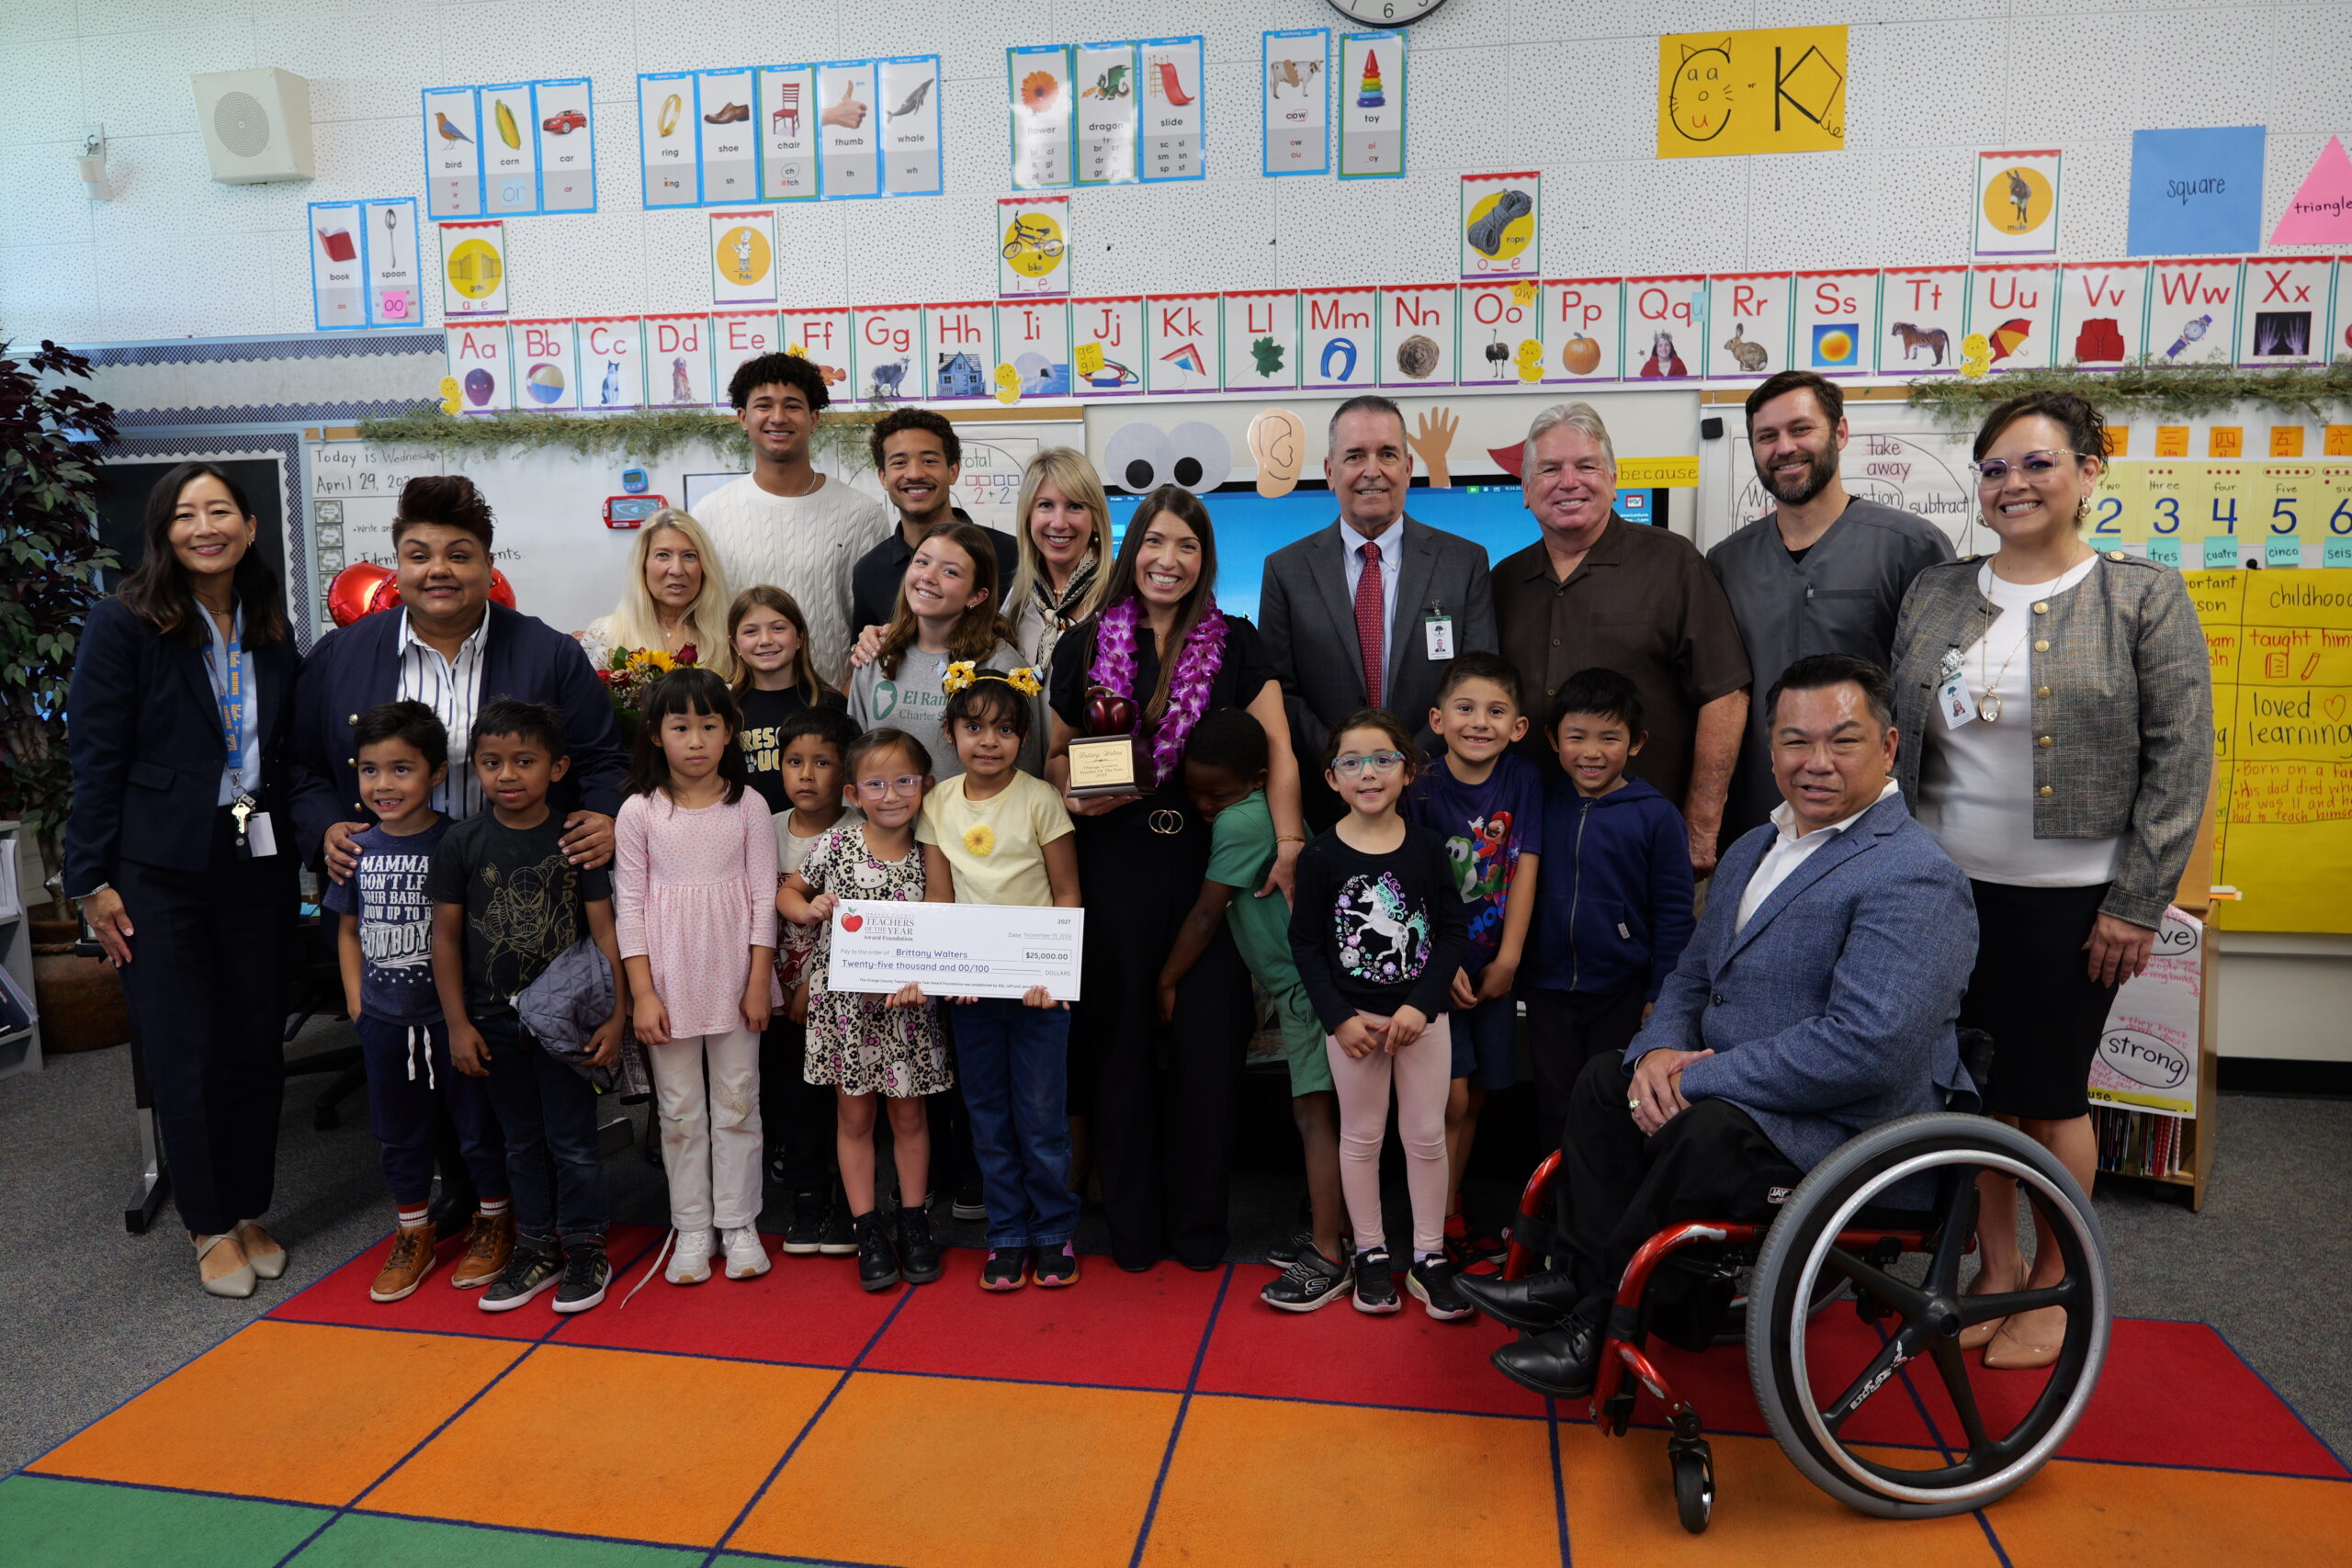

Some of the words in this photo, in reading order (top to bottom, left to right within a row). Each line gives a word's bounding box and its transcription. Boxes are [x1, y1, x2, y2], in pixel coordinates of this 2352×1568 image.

[1383, 3, 1394, 18] 6
[1160, 118, 1183, 127] slide
[1286, 111, 1306, 120] cow
[1364, 114, 1380, 124] toy
[1089, 120, 1124, 133] dragon
[777, 141, 800, 150] chair
[835, 137, 864, 147] thumb
[897, 134, 925, 143] whale
[1178, 140, 1184, 148] sl
[662, 148, 679, 159] ring
[718, 144, 739, 153] shoe
[1046, 148, 1054, 156] cl
[1093, 144, 1102, 152] br
[445, 160, 462, 169] bird
[500, 158, 520, 166] corn
[1046, 160, 1053, 169] gl
[1095, 156, 1104, 164] dr
[1369, 154, 1378, 164] oy
[785, 167, 795, 175] ch
[846, 169, 854, 177] th
[906, 166, 918, 175] wh
[1094, 169, 1102, 178] gr
[1159, 165, 1170, 174] sp
[1178, 164, 1186, 172] st
[726, 176, 735, 185] sh
[503, 186, 526, 202] or
[2166, 175, 2225, 206] square
[2294, 196, 2352, 218] triangle
[1506, 235, 1525, 244] rope
[381, 270, 407, 279] spoon
[1027, 263, 1043, 272] bike
[330, 273, 350, 281] book
[1514, 288, 1532, 300] aw
[1989, 276, 2039, 310] Uu
[2082, 274, 2125, 308] Vv
[2160, 272, 2232, 306] Ww
[2261, 269, 2312, 303] Xx
[1733, 286, 1769, 317] Rr
[1815, 282, 1857, 315] Ss
[1905, 278, 1943, 311] Tt
[1310, 299, 1372, 330] Mm
[1396, 296, 1440, 327] Nn
[1474, 292, 1522, 324] Oo
[1562, 290, 1602, 330] Pp
[1023, 310, 1041, 341] Ii
[1163, 306, 1204, 337] Kk
[1248, 302, 1272, 333] Ll
[729, 321, 765, 350] Ee
[804, 321, 833, 350] Ff
[865, 315, 909, 352] Gg
[939, 314, 981, 344] Hh
[1093, 309, 1121, 346] Jj
[459, 332, 497, 359] Aa
[526, 330, 561, 357] Bb
[590, 327, 627, 355] Cc
[659, 324, 697, 353] Dd
[1867, 434, 1901, 456] take
[2161, 430, 2180, 446] 三
[2215, 431, 2235, 449] 四
[2276, 431, 2293, 446] 五
[2331, 428, 2349, 446] 六
[315, 449, 356, 468] Today
[365, 453, 377, 463] is
[960, 448, 991, 468] total
[1621, 464, 1699, 481] because
[1867, 461, 1911, 483] away
[316, 475, 352, 494] April
[359, 472, 379, 491] 29,
[2149, 480, 2180, 491] three
[2214, 482, 2237, 491] four
[2276, 483, 2298, 493] five
[2335, 485, 2352, 493] six
[973, 486, 985, 504] 2
[999, 486, 1012, 504] 2
[1909, 492, 1967, 515] subtract
[2096, 497, 2122, 534] 2
[2154, 497, 2179, 534] 3
[2212, 498, 2237, 534] 4
[2270, 498, 2297, 534] 5
[2330, 498, 2352, 535] 6
[357, 525, 378, 533] Write
[2150, 548, 2178, 562] tres
[2205, 548, 2237, 561] cuatro
[2268, 547, 2299, 558] cinco
[2327, 548, 2352, 559] seis
[2249, 628, 2312, 656] taught
[903, 690, 918, 705] El
[2254, 690, 2311, 719] loved
[899, 709, 935, 721] Charter
[739, 727, 780, 751] RES
[2249, 721, 2352, 759] learning
[2244, 760, 2279, 776] Born
[2288, 763, 2307, 775] on
[2316, 766, 2324, 776] a
[2267, 778, 2290, 795] dad
[2296, 778, 2323, 795] died
[2236, 798, 2250, 810] he
[2257, 797, 2284, 809] was
[2308, 795, 2335, 810] and
[2233, 809, 2251, 823] had
[2257, 811, 2267, 822] to
[2276, 807, 2308, 822] teach
[360, 855, 429, 873] MAMMA
[360, 874, 402, 890] DON'T
[361, 891, 386, 904] YOUR
[387, 906, 401, 920] UP
[404, 906, 420, 919] TO
[866, 918, 914, 927] TEACHERS
[888, 927, 913, 935] YEAR
[359, 921, 432, 958] COWBOY
[896, 948, 931, 958] Brittany
[934, 950, 968, 959] Walters
[1025, 952, 1069, 961] $25,000.00
[842, 959, 894, 969] Twenty-five
[897, 962, 937, 971] thousand
[940, 964, 956, 972] and
[958, 964, 989, 974] 00/100
[2109, 1036, 2184, 1084] strong
[1770, 1189, 1786, 1198] JAY
